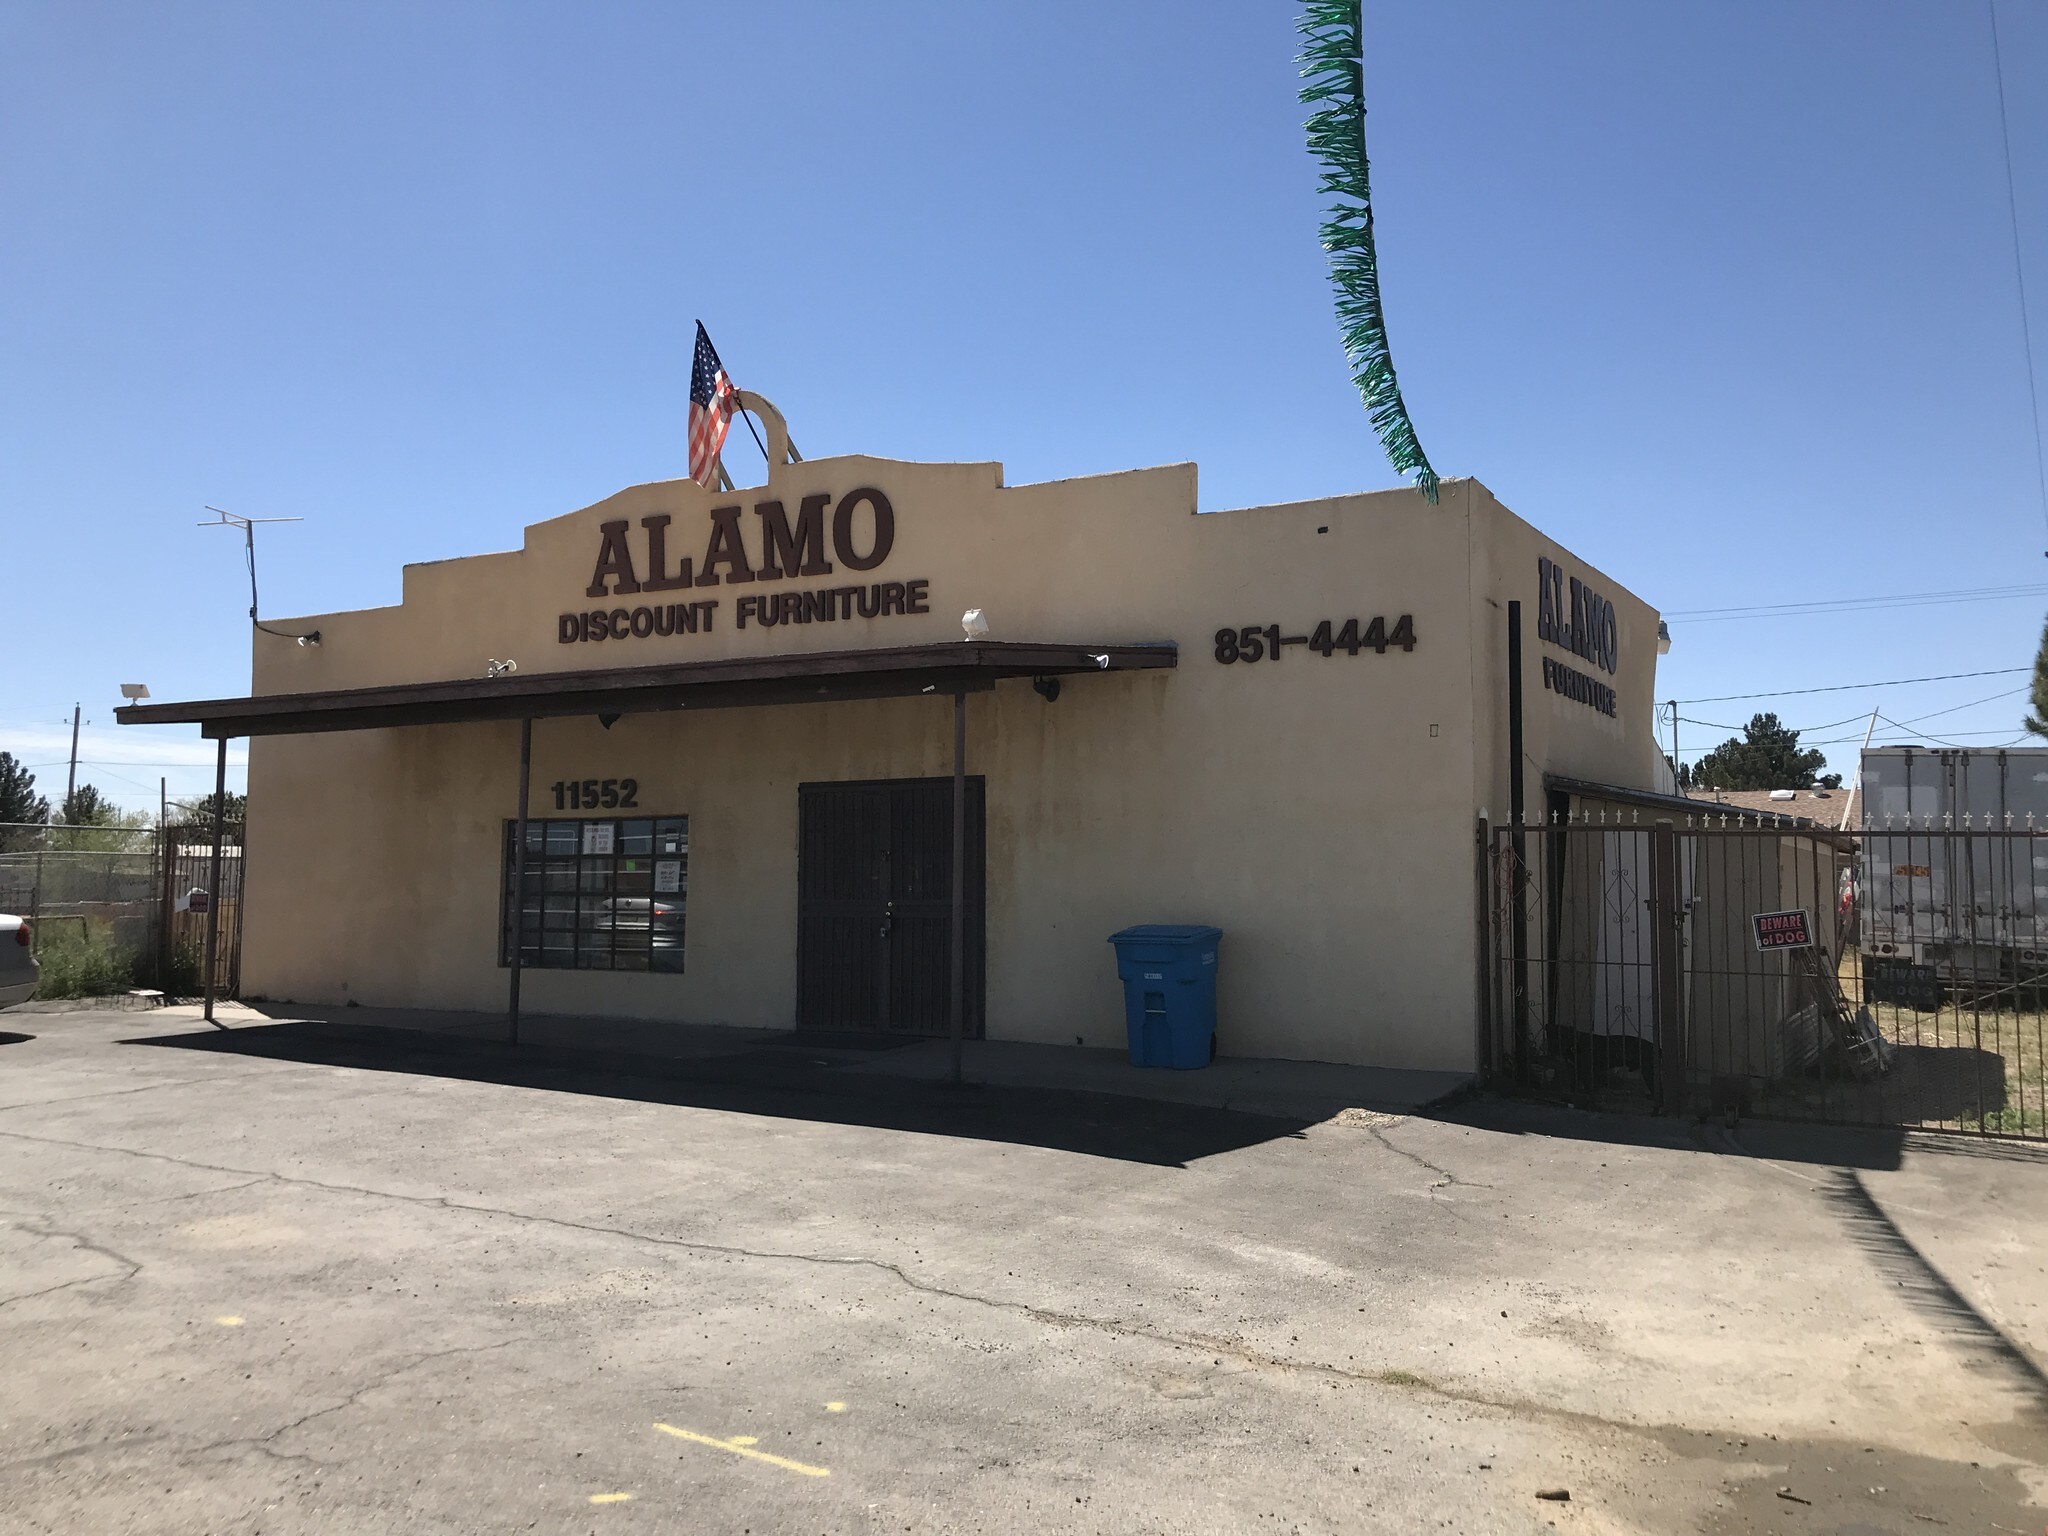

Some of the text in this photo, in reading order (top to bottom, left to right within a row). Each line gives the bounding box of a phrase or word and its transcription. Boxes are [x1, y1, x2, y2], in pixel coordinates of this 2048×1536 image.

[586, 487, 895, 598] ALAMO
[558, 580, 930, 644] DISCOUNT FURNITURE
[1214, 614, 1417, 665] 851-4444
[1538, 556, 1618, 675] ALAMO
[1543, 656, 1617, 718] FURNITURE
[551, 778, 639, 811] 11552
[1760, 914, 1802, 931] BEWARE
[1762, 931, 1806, 946] of DOG
